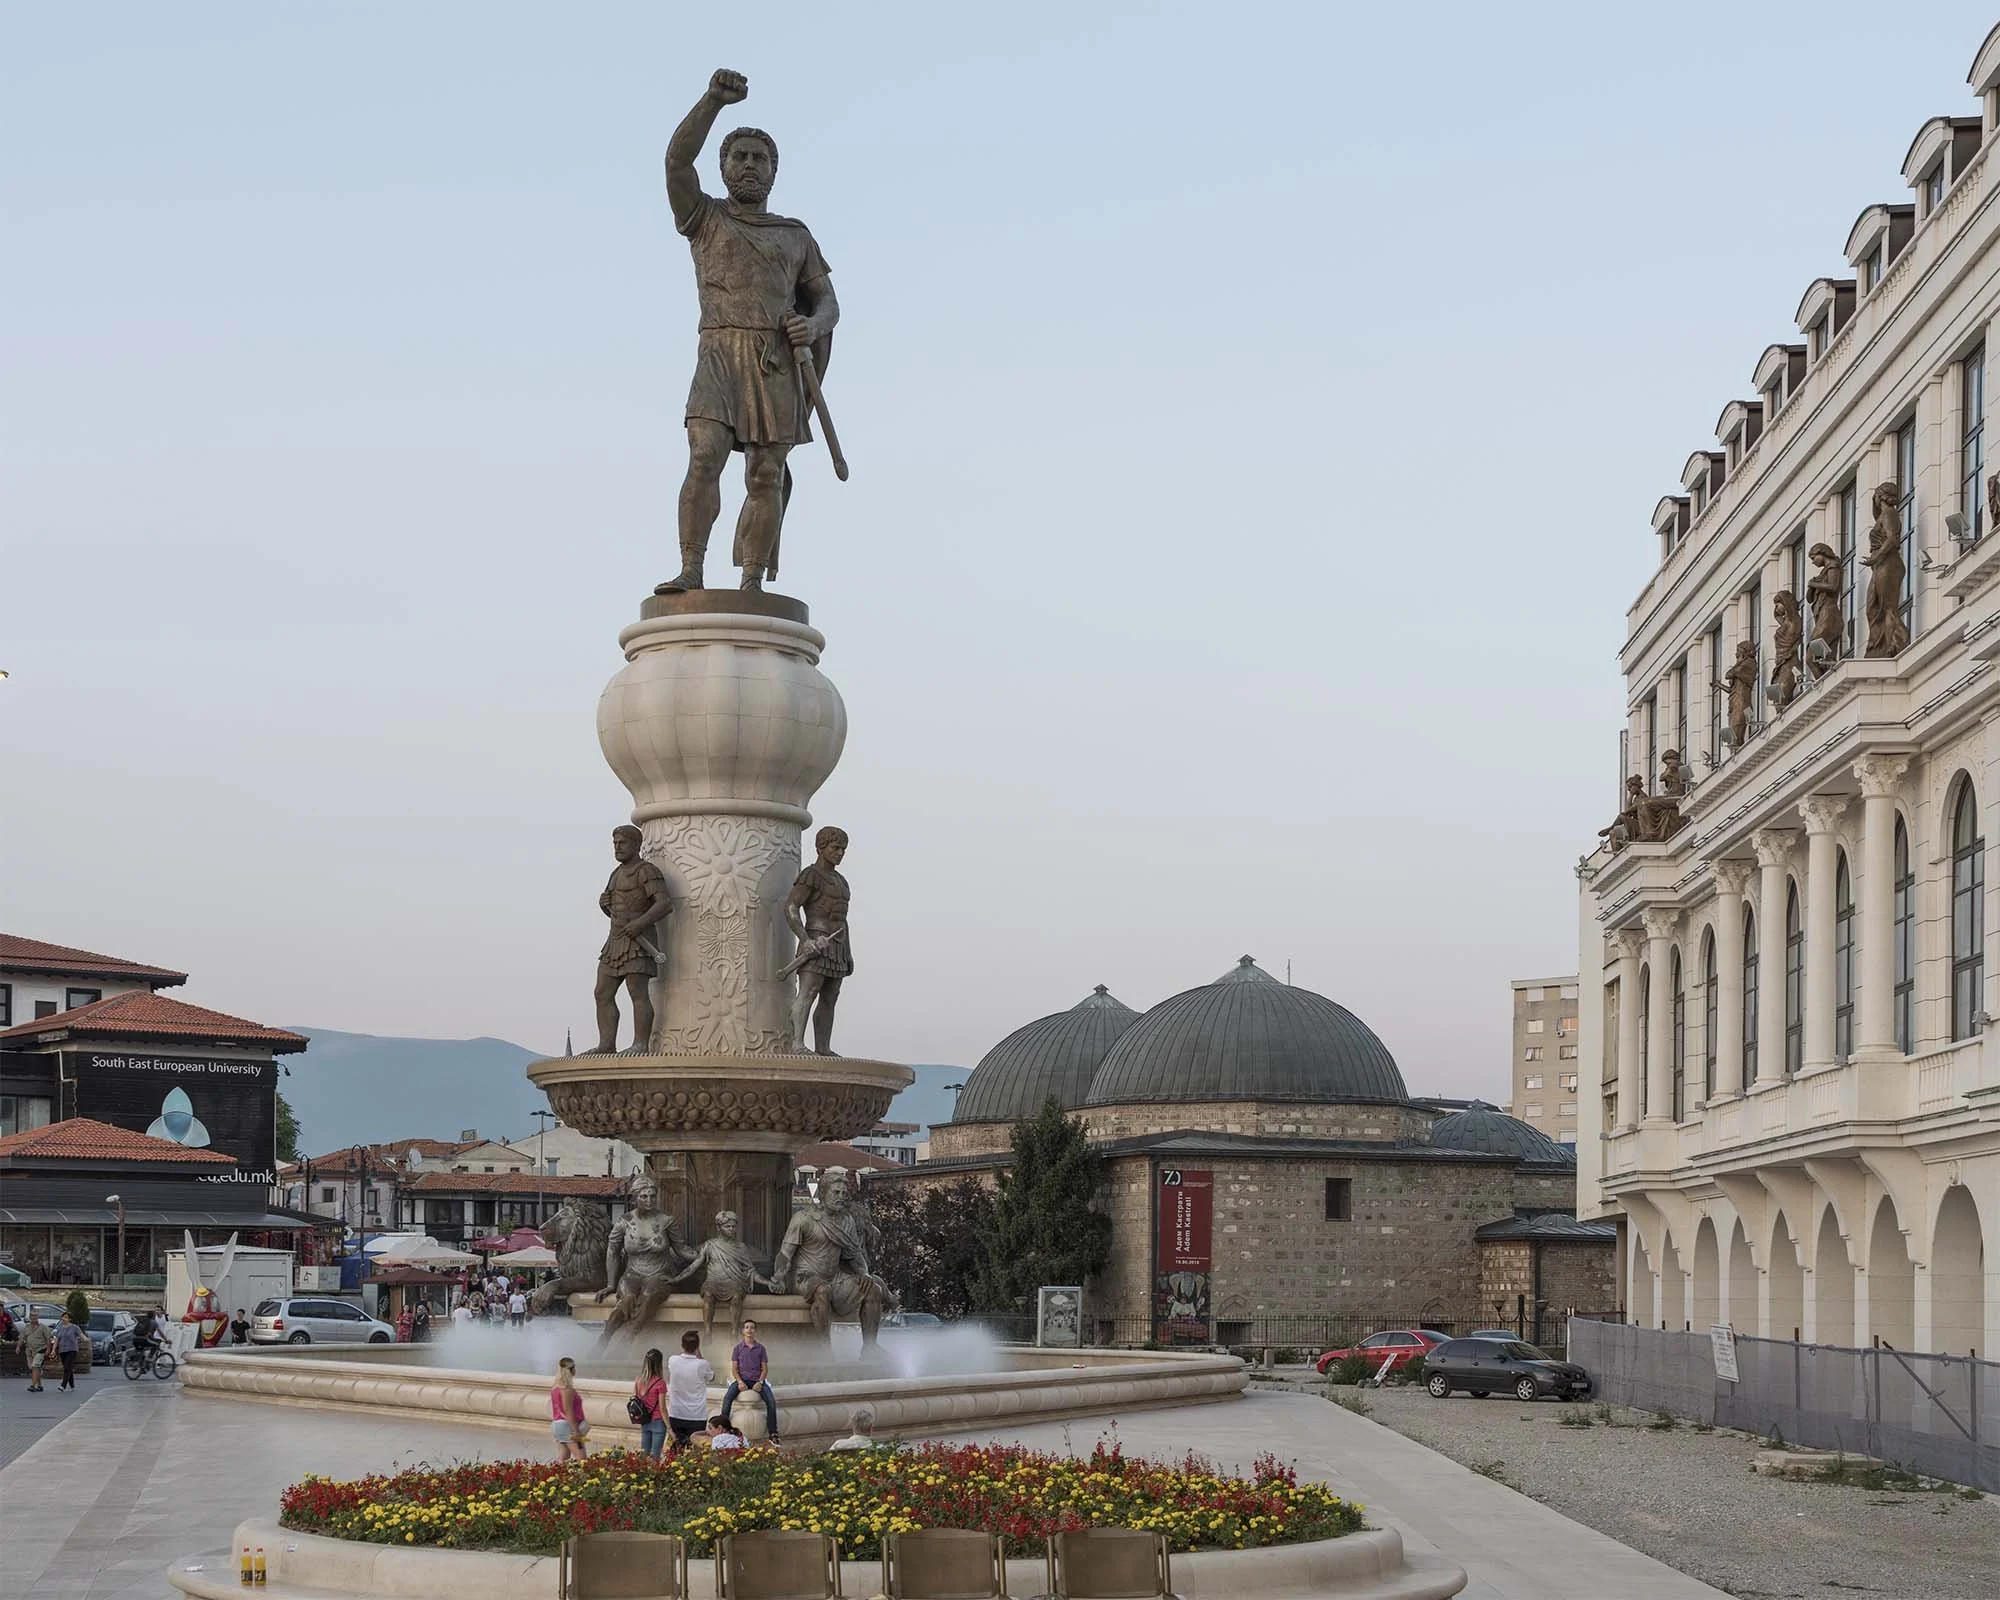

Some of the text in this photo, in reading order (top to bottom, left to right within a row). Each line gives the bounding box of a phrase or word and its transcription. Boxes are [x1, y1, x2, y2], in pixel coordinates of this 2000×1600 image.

[91, 1055, 262, 1077] South East European University
